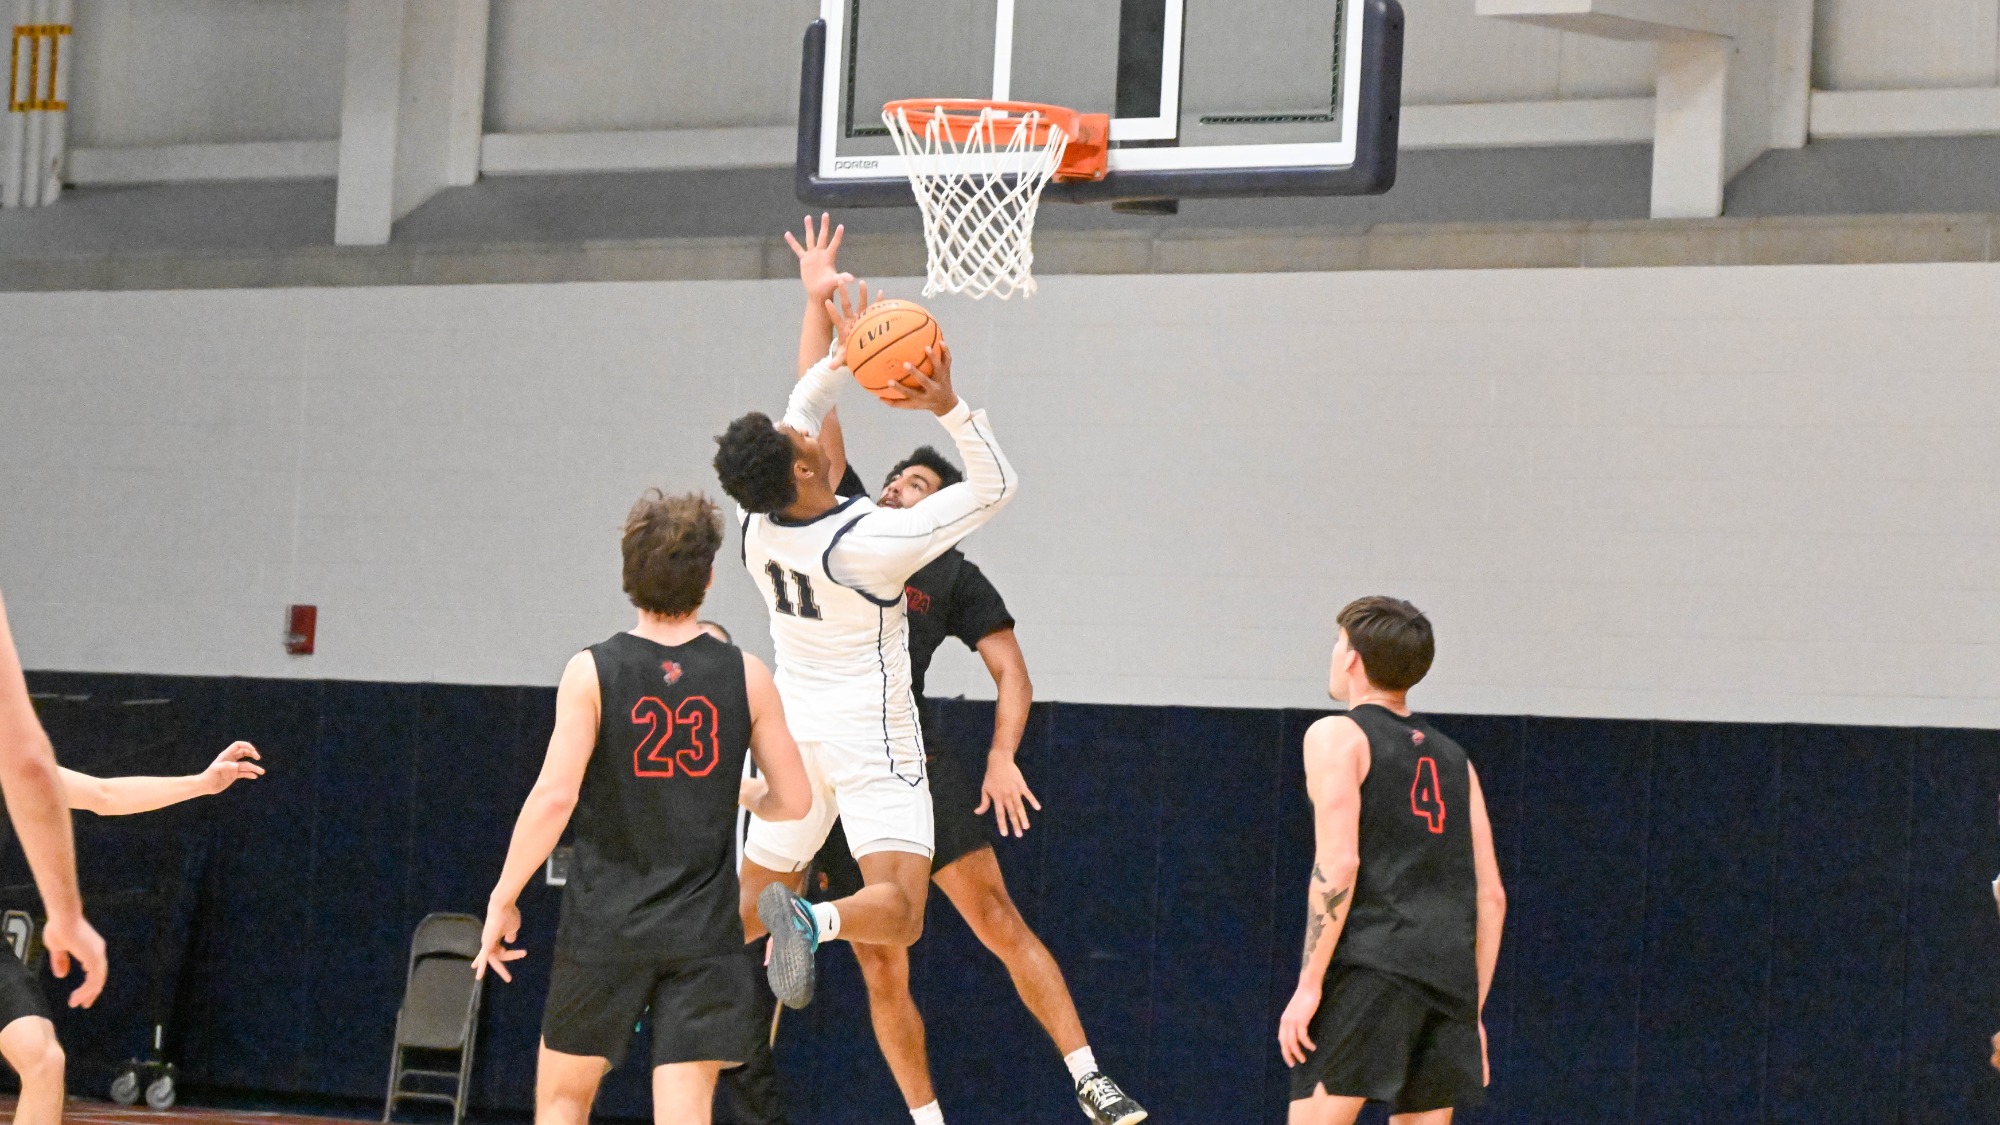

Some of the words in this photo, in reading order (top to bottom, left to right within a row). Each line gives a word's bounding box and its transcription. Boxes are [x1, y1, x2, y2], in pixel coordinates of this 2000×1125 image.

[764, 558, 823, 621] 11
[630, 695, 720, 778] 23
[1409, 756, 1447, 834] 4
